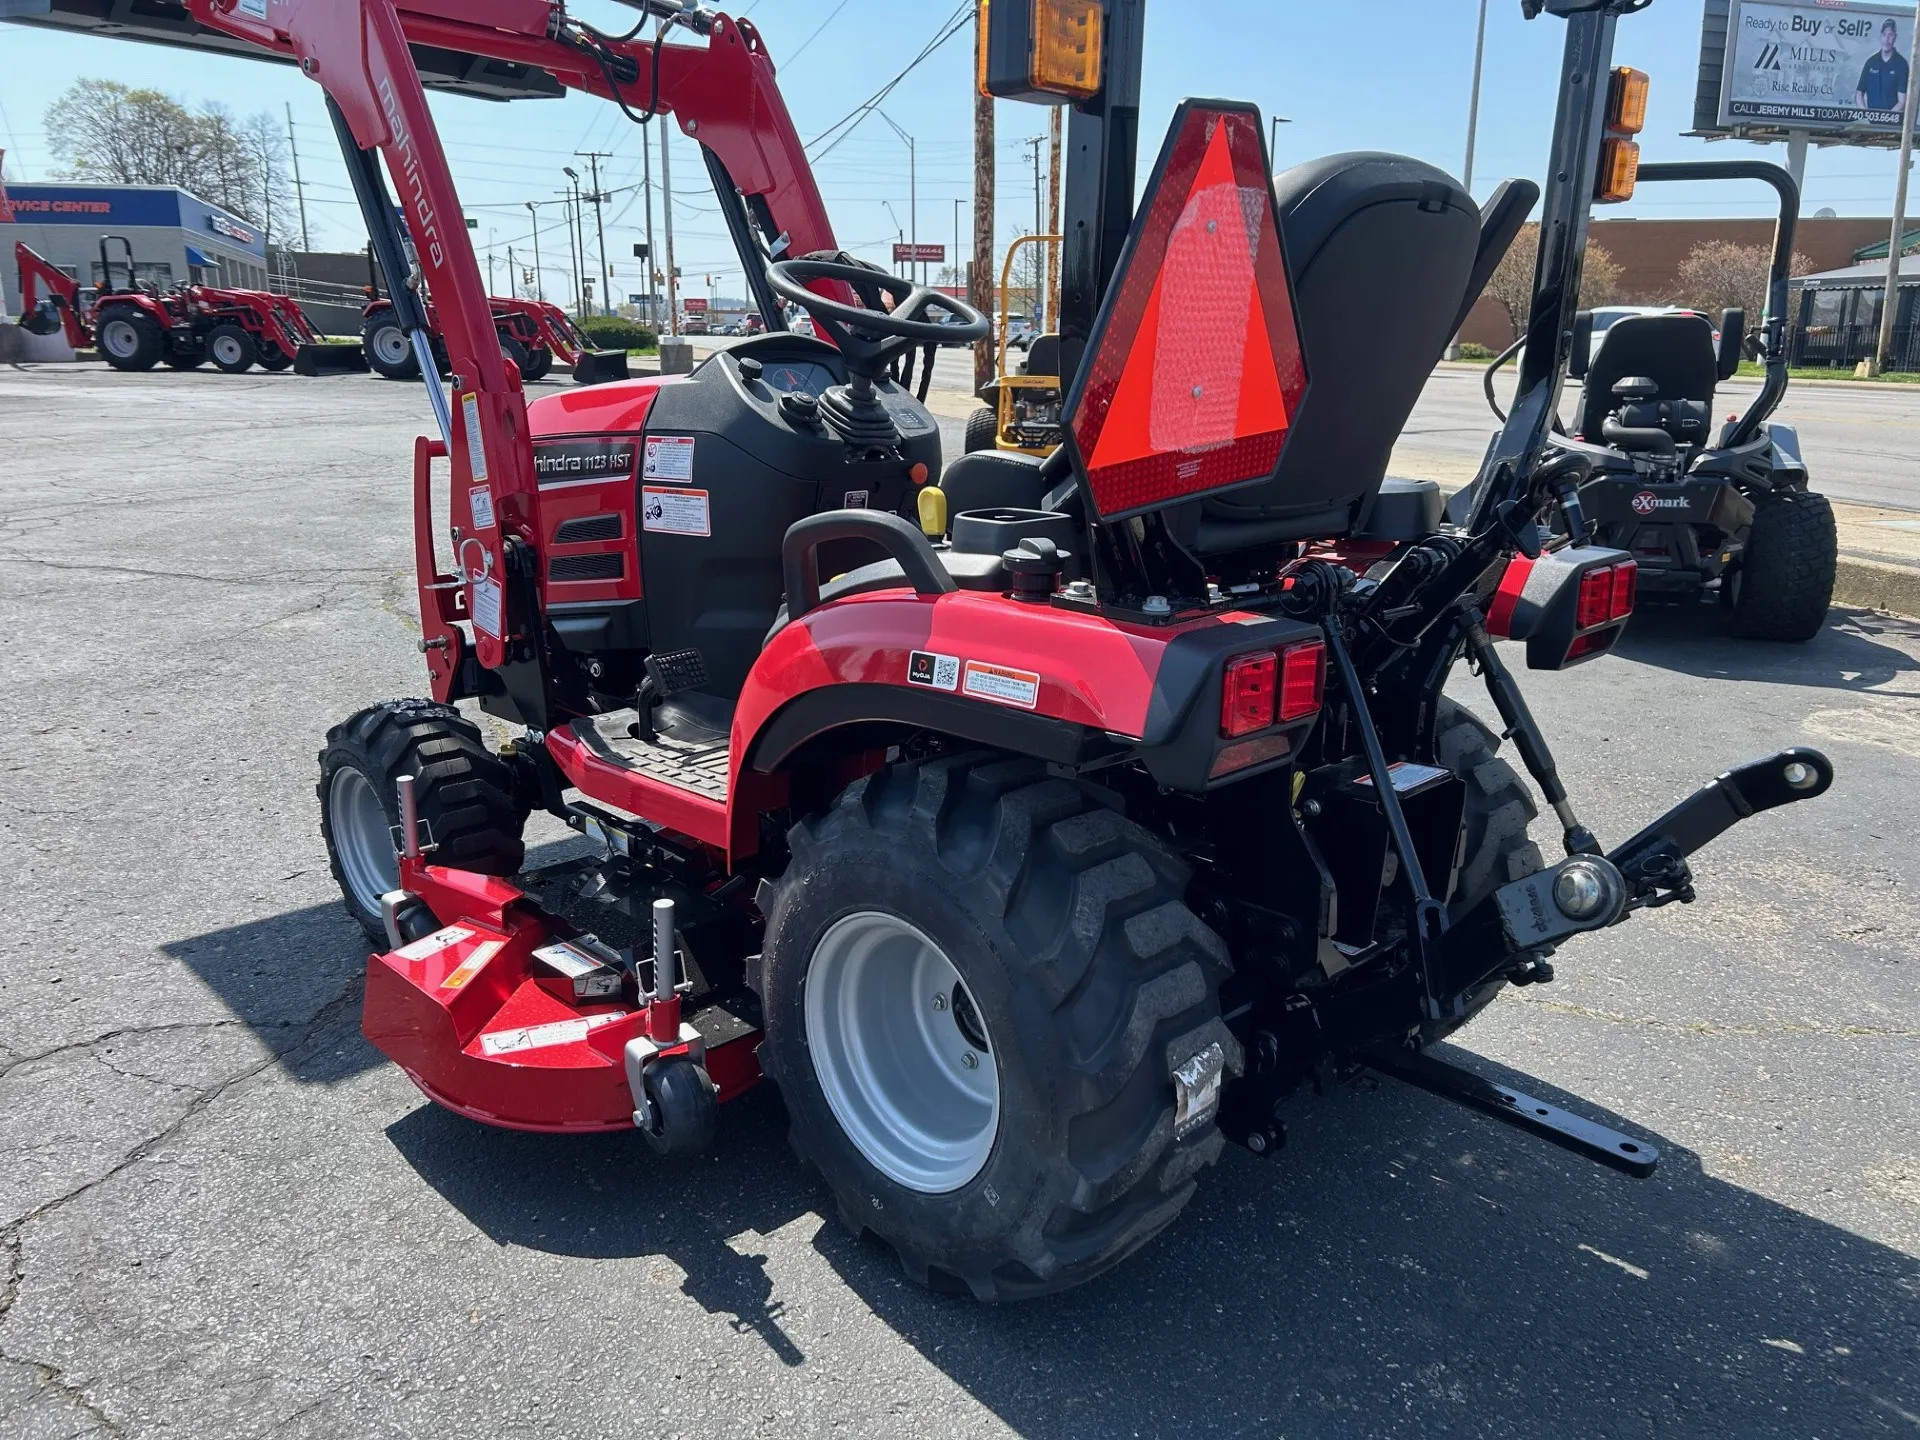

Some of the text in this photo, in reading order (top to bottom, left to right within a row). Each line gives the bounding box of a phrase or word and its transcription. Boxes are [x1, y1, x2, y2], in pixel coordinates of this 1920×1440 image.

[1745, 15, 1872, 37] Ready to Buy or Sell?
[1789, 47, 1836, 63] MILLS
[1772, 80, 1834, 96] Rise Realty Co.
[1733, 103, 1755, 114] CALL
[1757, 105, 1790, 116] JEREMY
[1791, 107, 1815, 118] MILLS
[1816, 108, 1847, 119] TODAY!
[379, 76, 444, 270] mahindra
[8, 200, 111, 213] RVICE CENTER
[533, 453, 631, 472] hindra 1123 HST
